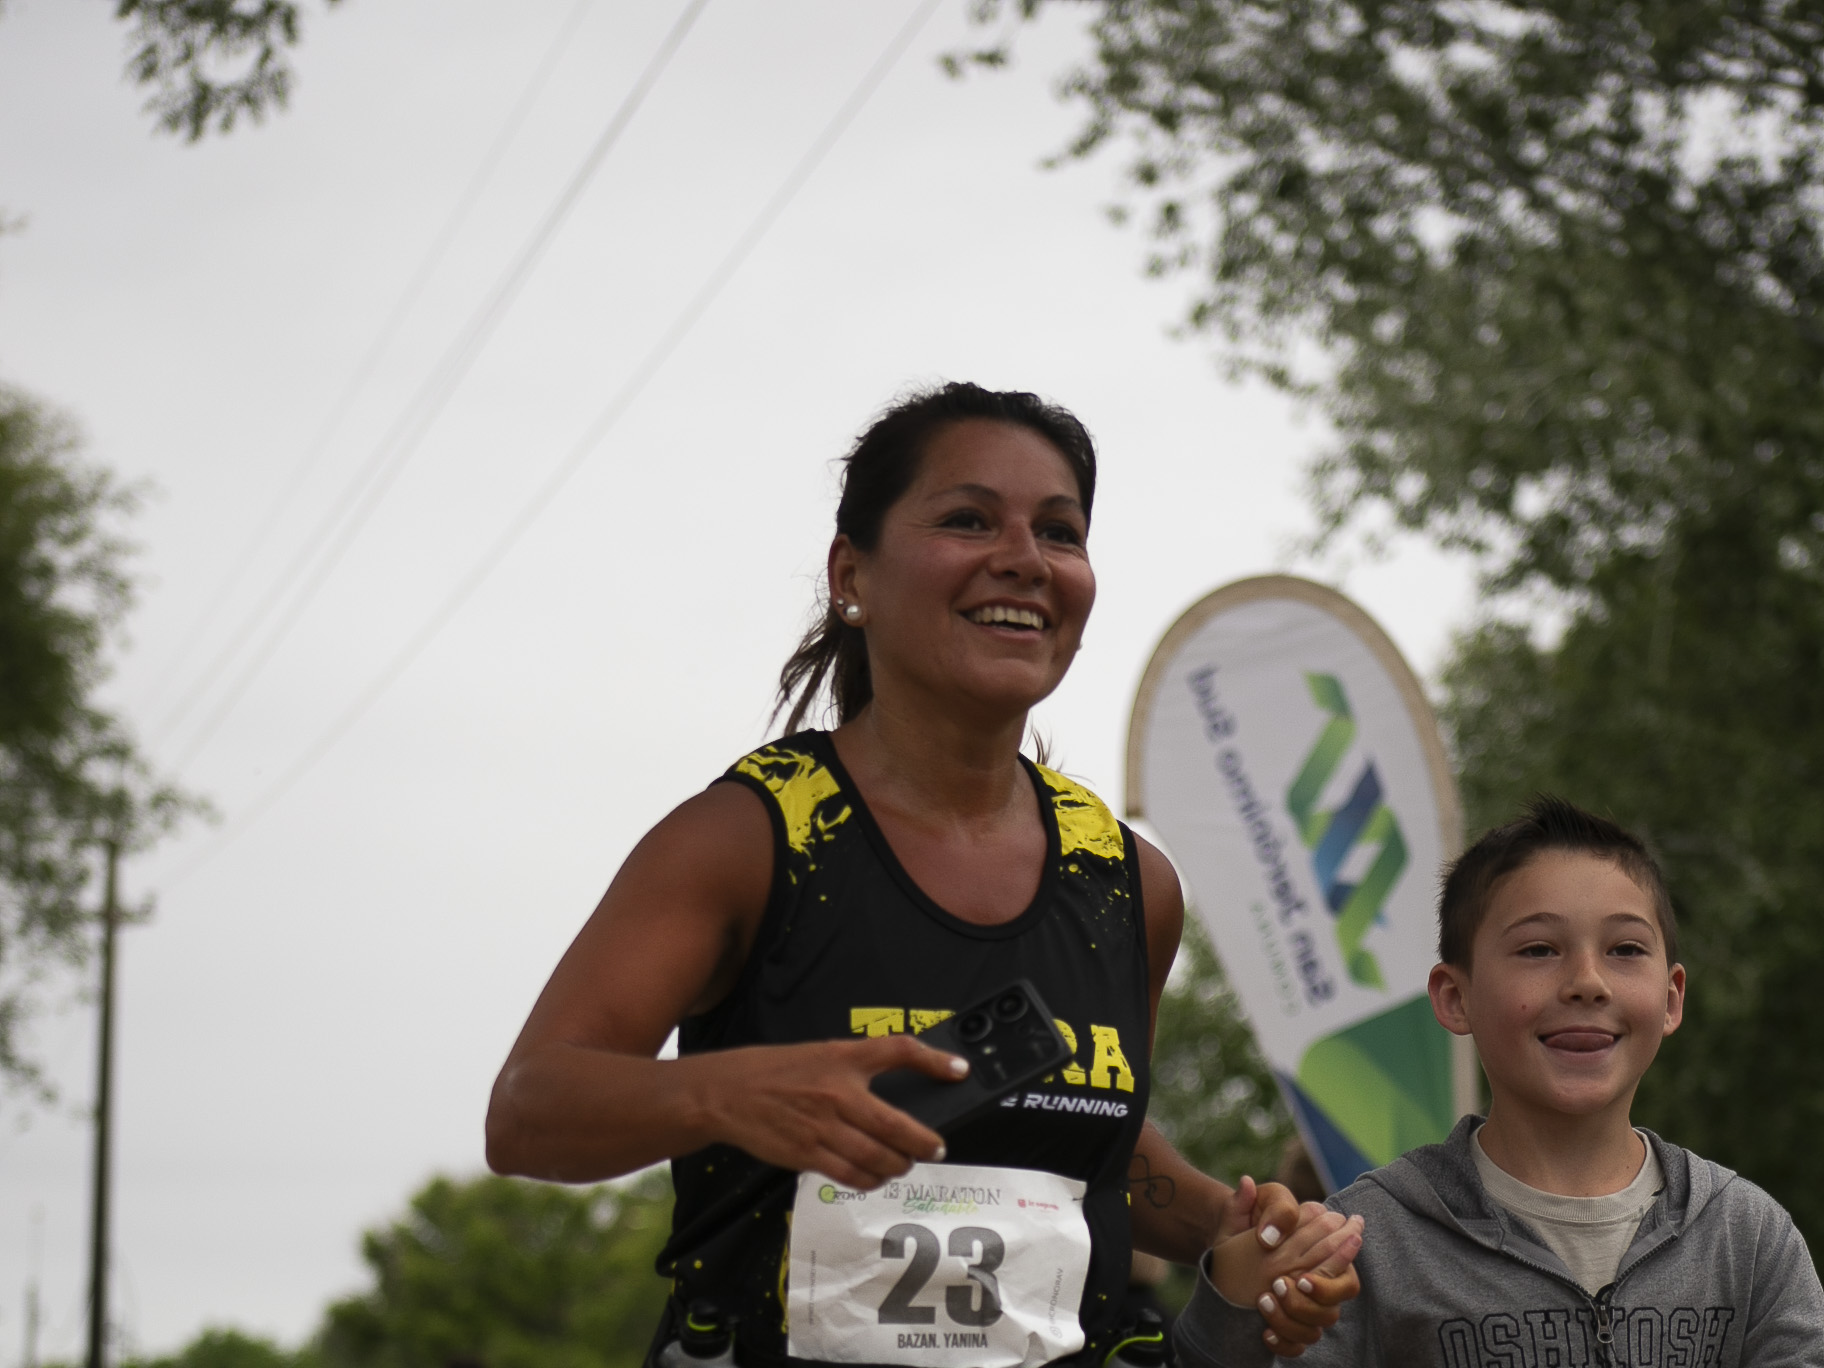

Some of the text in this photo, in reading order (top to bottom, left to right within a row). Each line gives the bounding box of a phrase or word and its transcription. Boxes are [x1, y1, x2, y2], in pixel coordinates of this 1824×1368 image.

[1023, 1093, 1128, 1117] RUNNING
[904, 1184, 1001, 1205] MARATON
[878, 1223, 1005, 1327] 23
[944, 1333, 988, 1348] YANINA
